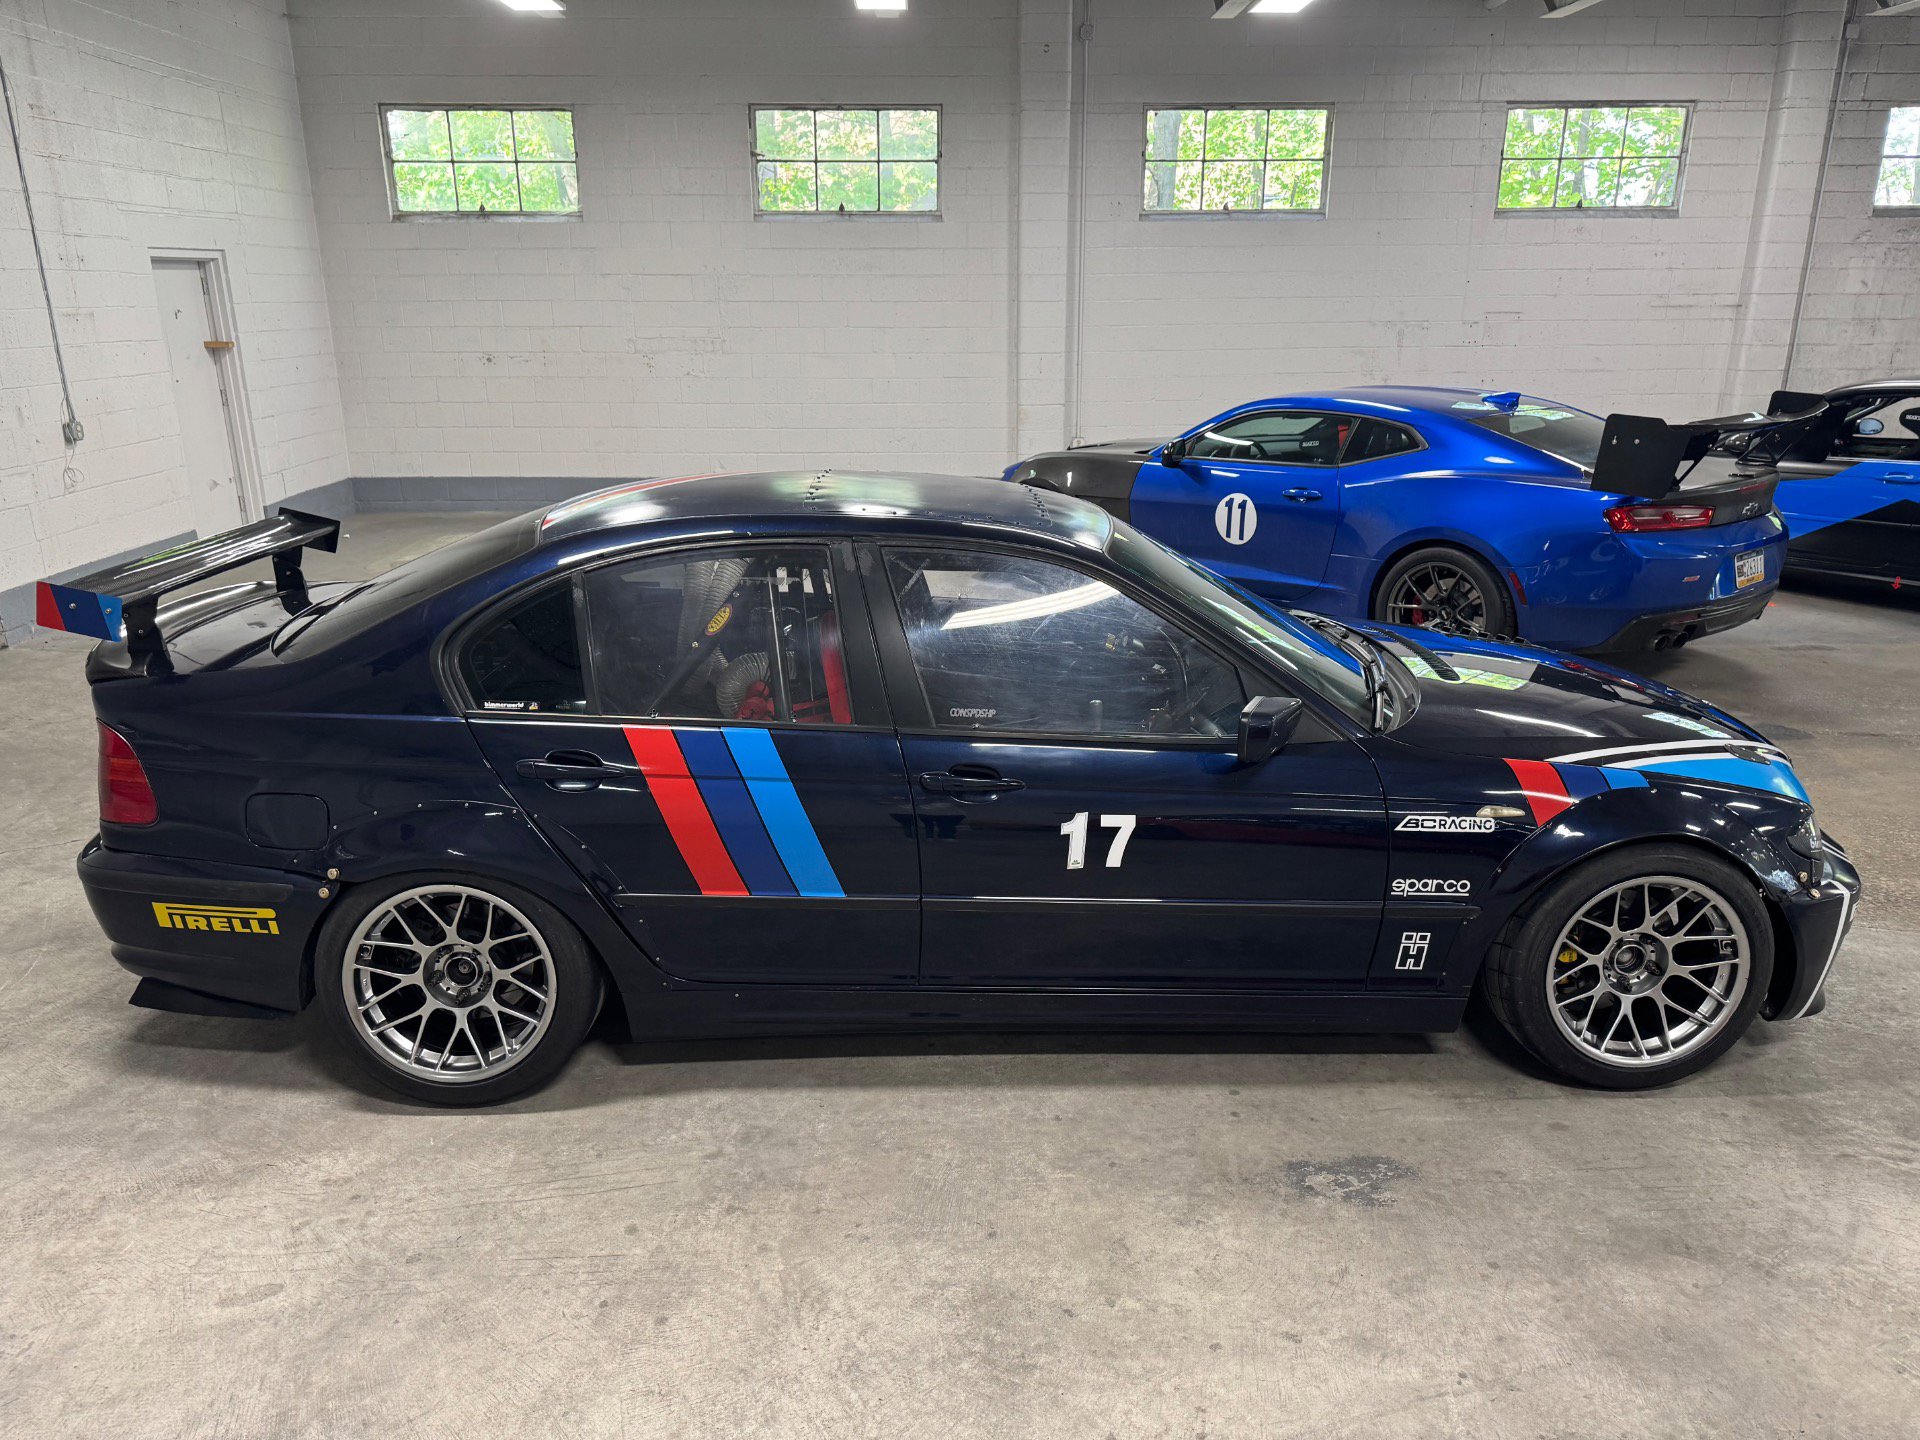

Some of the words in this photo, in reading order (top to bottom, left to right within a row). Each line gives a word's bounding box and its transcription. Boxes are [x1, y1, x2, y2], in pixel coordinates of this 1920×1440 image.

[1224, 497, 1248, 541] 11
[1060, 811, 1136, 870] 17
[1391, 878, 1471, 897] sparco
[151, 901, 280, 935] PIRELLI
